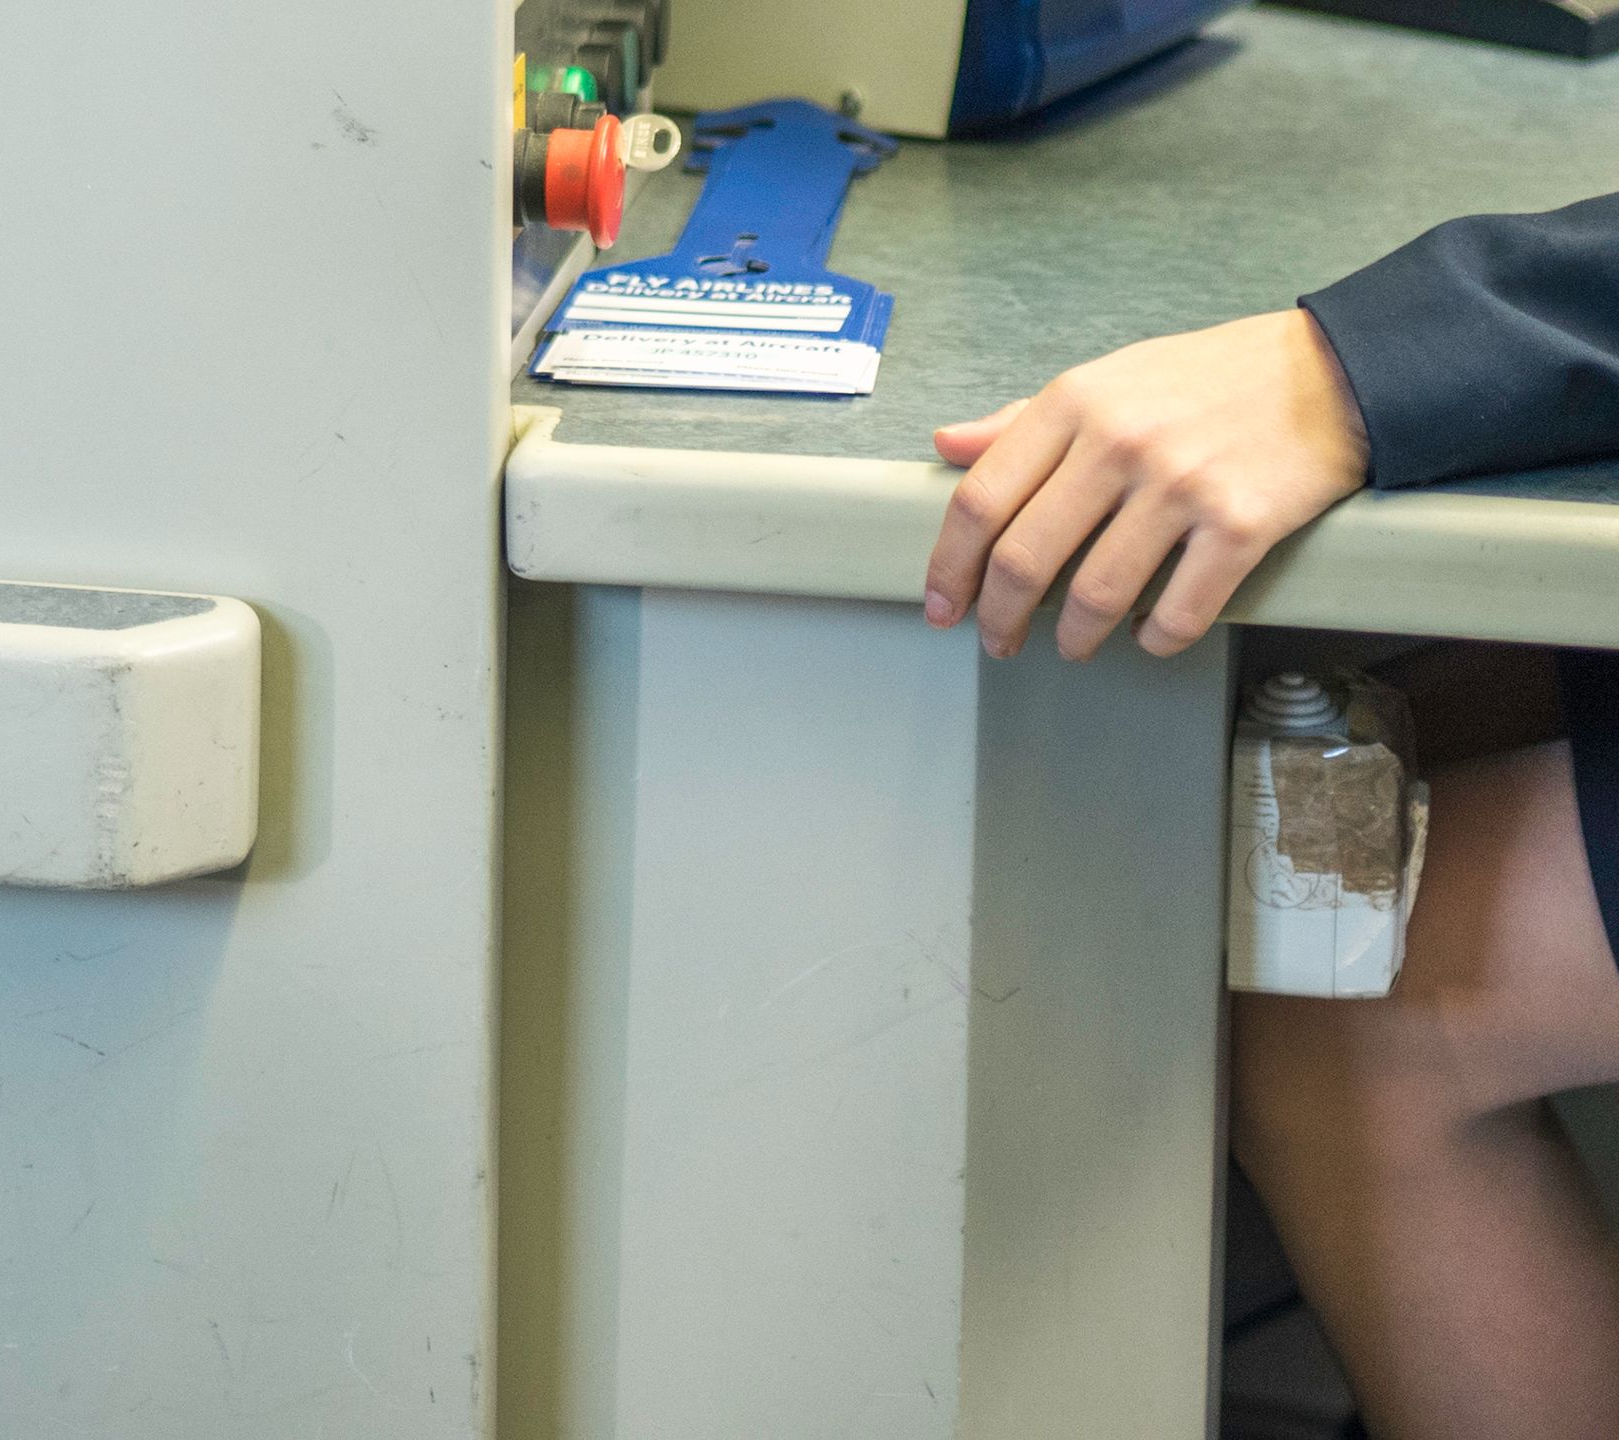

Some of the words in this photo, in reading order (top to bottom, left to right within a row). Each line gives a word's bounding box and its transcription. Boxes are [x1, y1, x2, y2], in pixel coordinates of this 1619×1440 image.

[585, 282, 705, 299] Delivery
[710, 292, 740, 301] at
[744, 292, 852, 305] Aircraft
[607, 272, 670, 288] FLY
[674, 277, 834, 296] AIRLINES
[582, 333, 697, 345] Delivery
[740, 339, 841, 354] Aircraft
